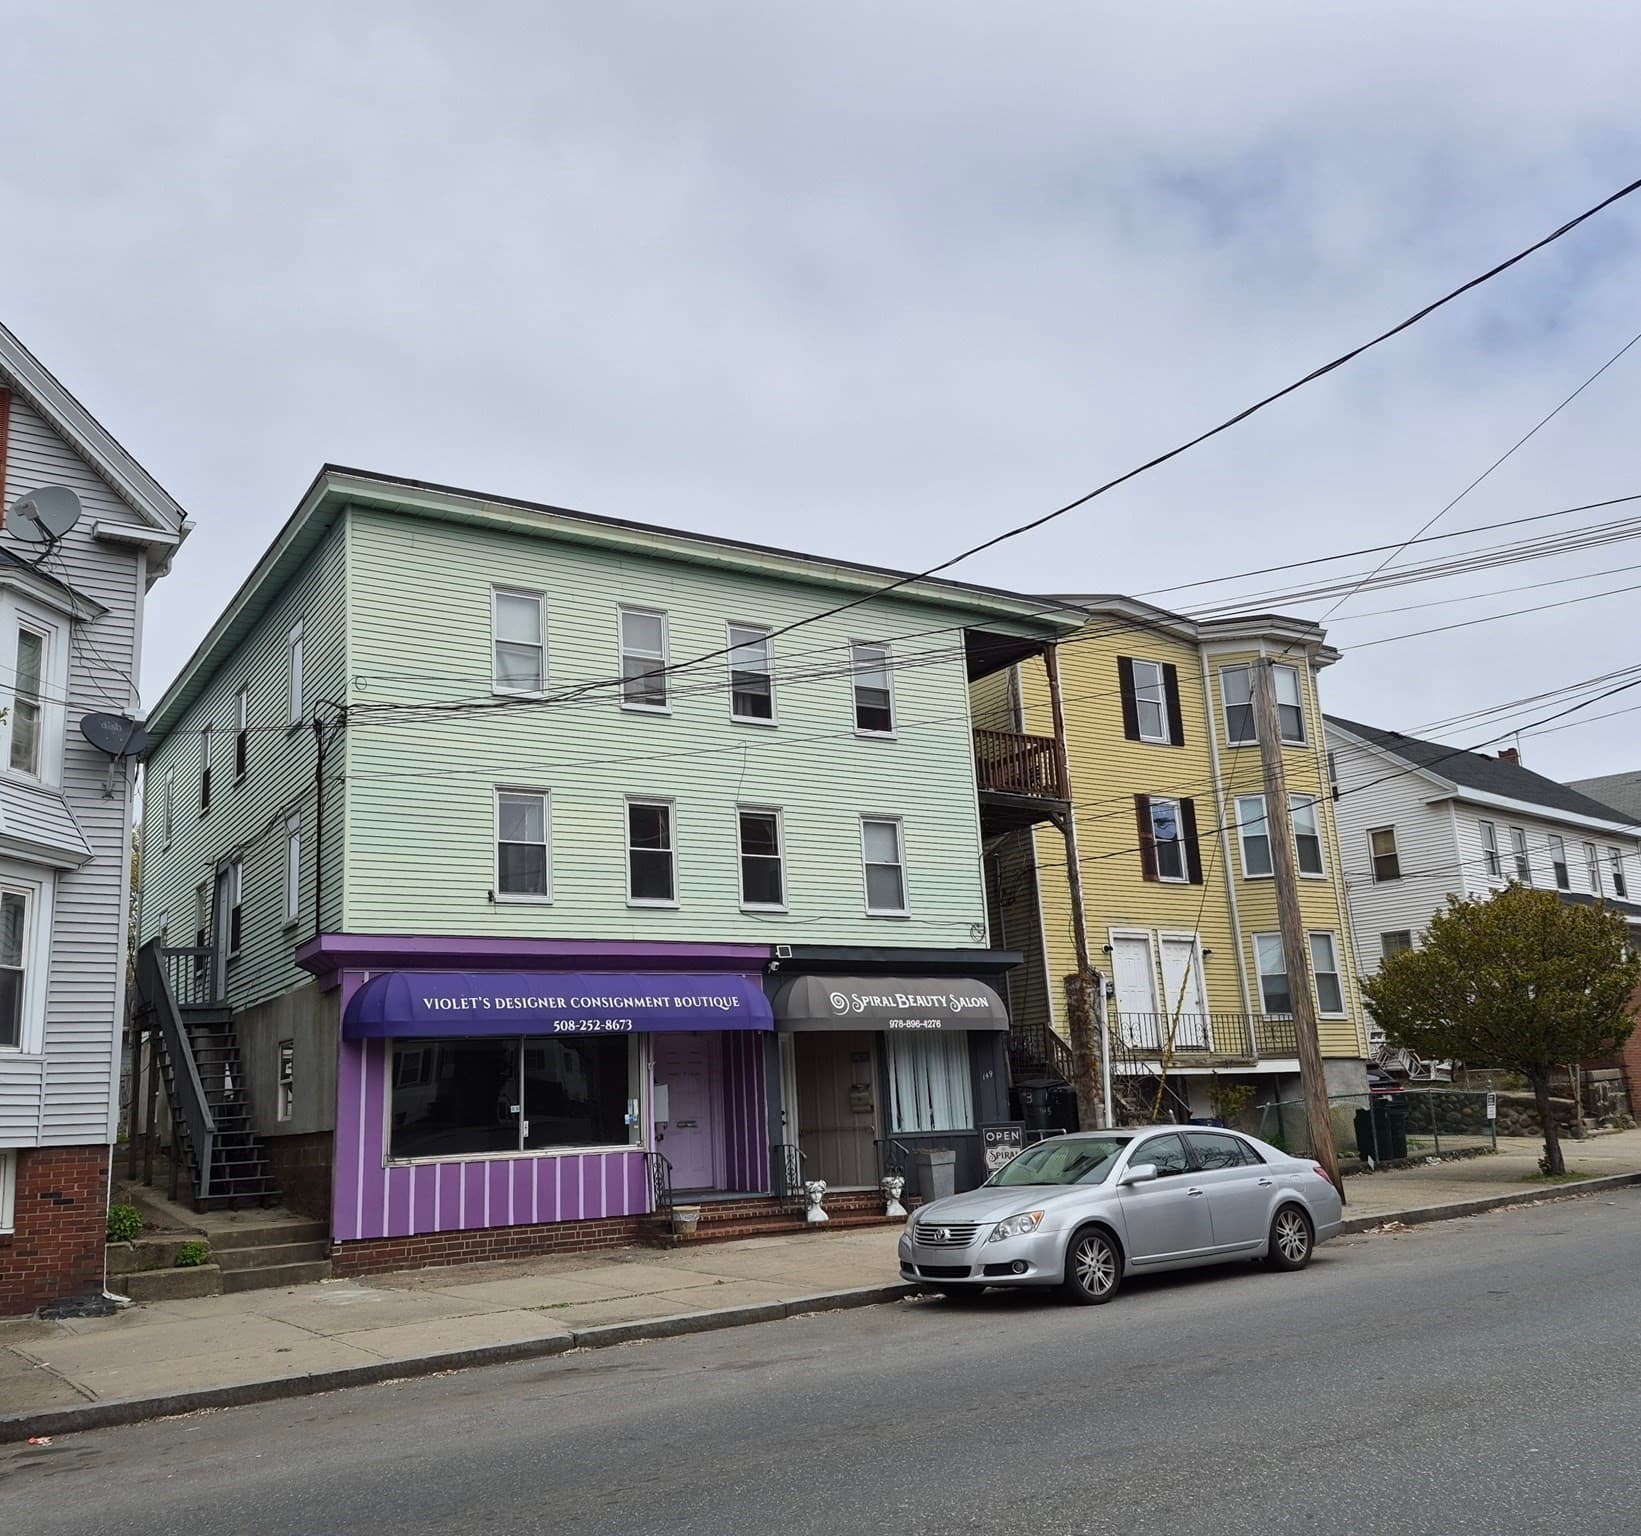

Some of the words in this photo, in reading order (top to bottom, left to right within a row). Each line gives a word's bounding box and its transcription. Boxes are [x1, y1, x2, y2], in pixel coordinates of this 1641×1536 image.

[423, 997, 491, 1010] VIOLET'S
[495, 997, 567, 1010] DESIGNER
[570, 996, 671, 1009] CONSIGNMENT
[674, 996, 740, 1011] BOUTIQUE
[851, 993, 897, 1012] SPIRAL
[895, 993, 948, 1008] BEAUTY
[949, 994, 989, 1012] SALON
[553, 1019, 633, 1032] 508-252-8673
[986, 1131, 1019, 1141] OPEN
